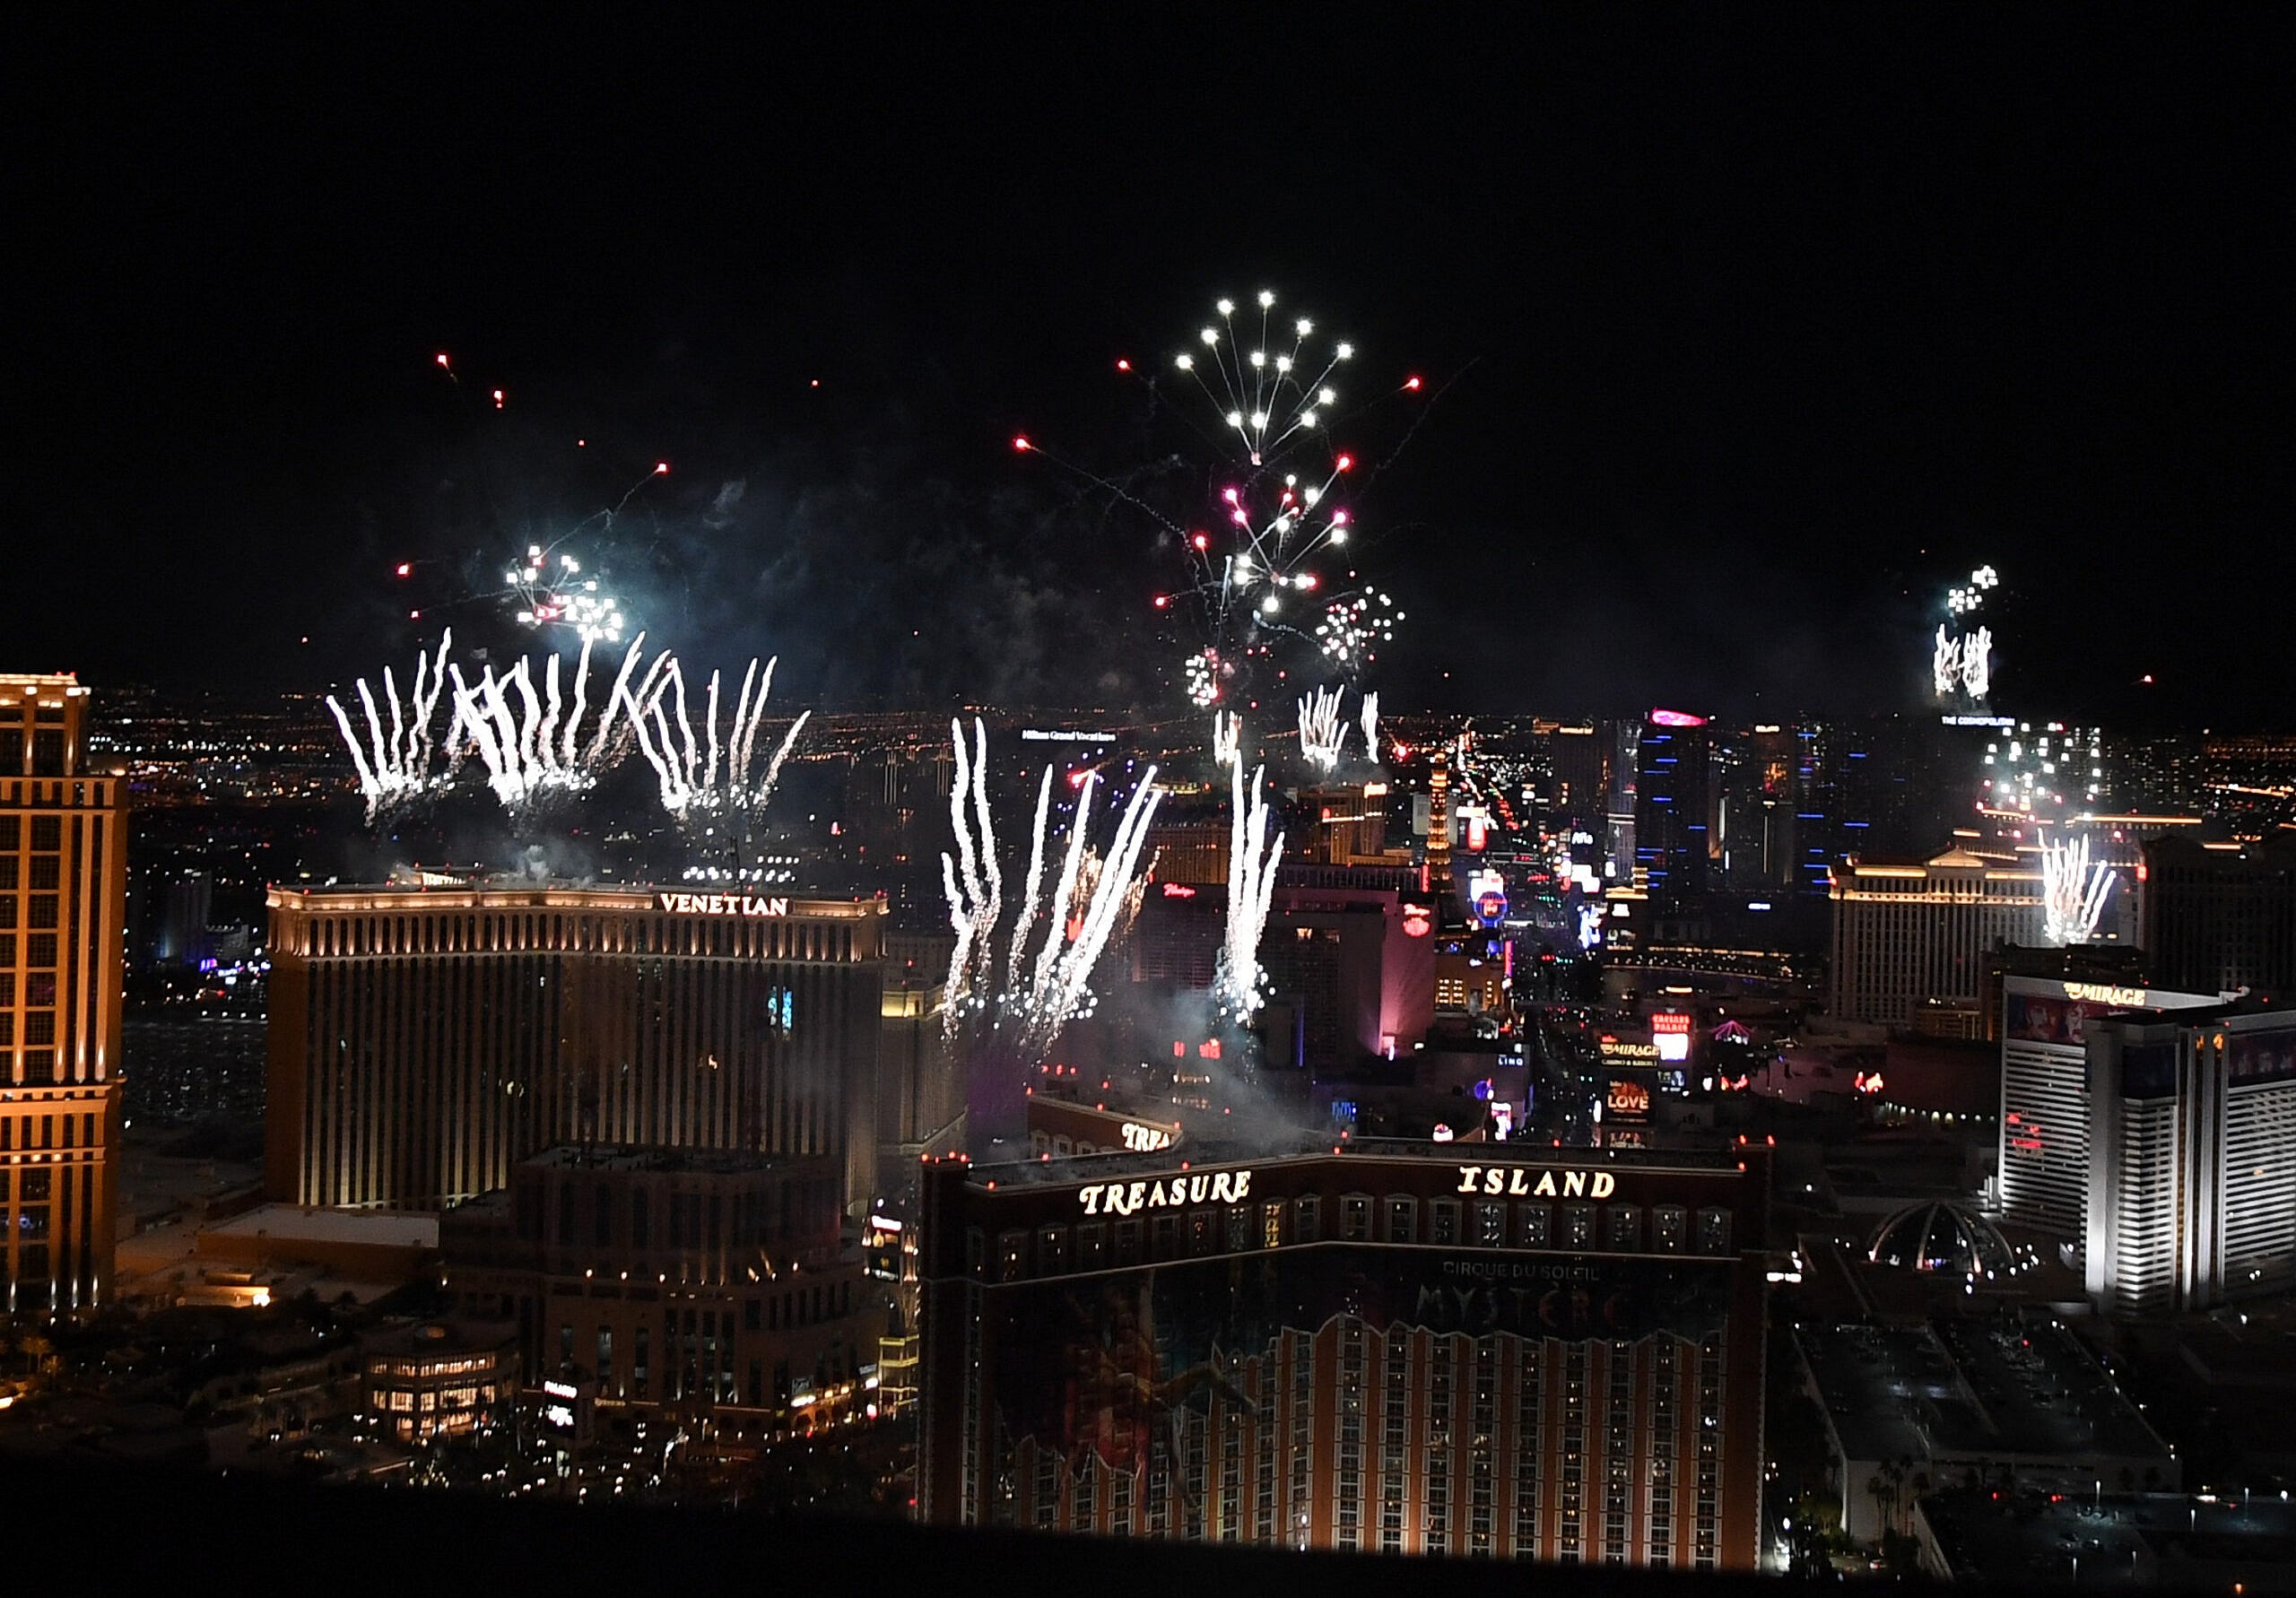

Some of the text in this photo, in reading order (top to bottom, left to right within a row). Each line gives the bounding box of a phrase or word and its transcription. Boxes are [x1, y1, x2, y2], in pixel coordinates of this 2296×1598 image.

[660, 893, 788, 916] VENETIAN
[2068, 984, 2146, 1006] MIRAGE
[1603, 1043, 1660, 1057] MIRAGE
[1607, 1094, 1649, 1109] LOVE
[1079, 1166, 1615, 1216] TREASURE ISLAND
[1443, 1262, 1508, 1281] CIRQUE
[1512, 1264, 1536, 1278] DU
